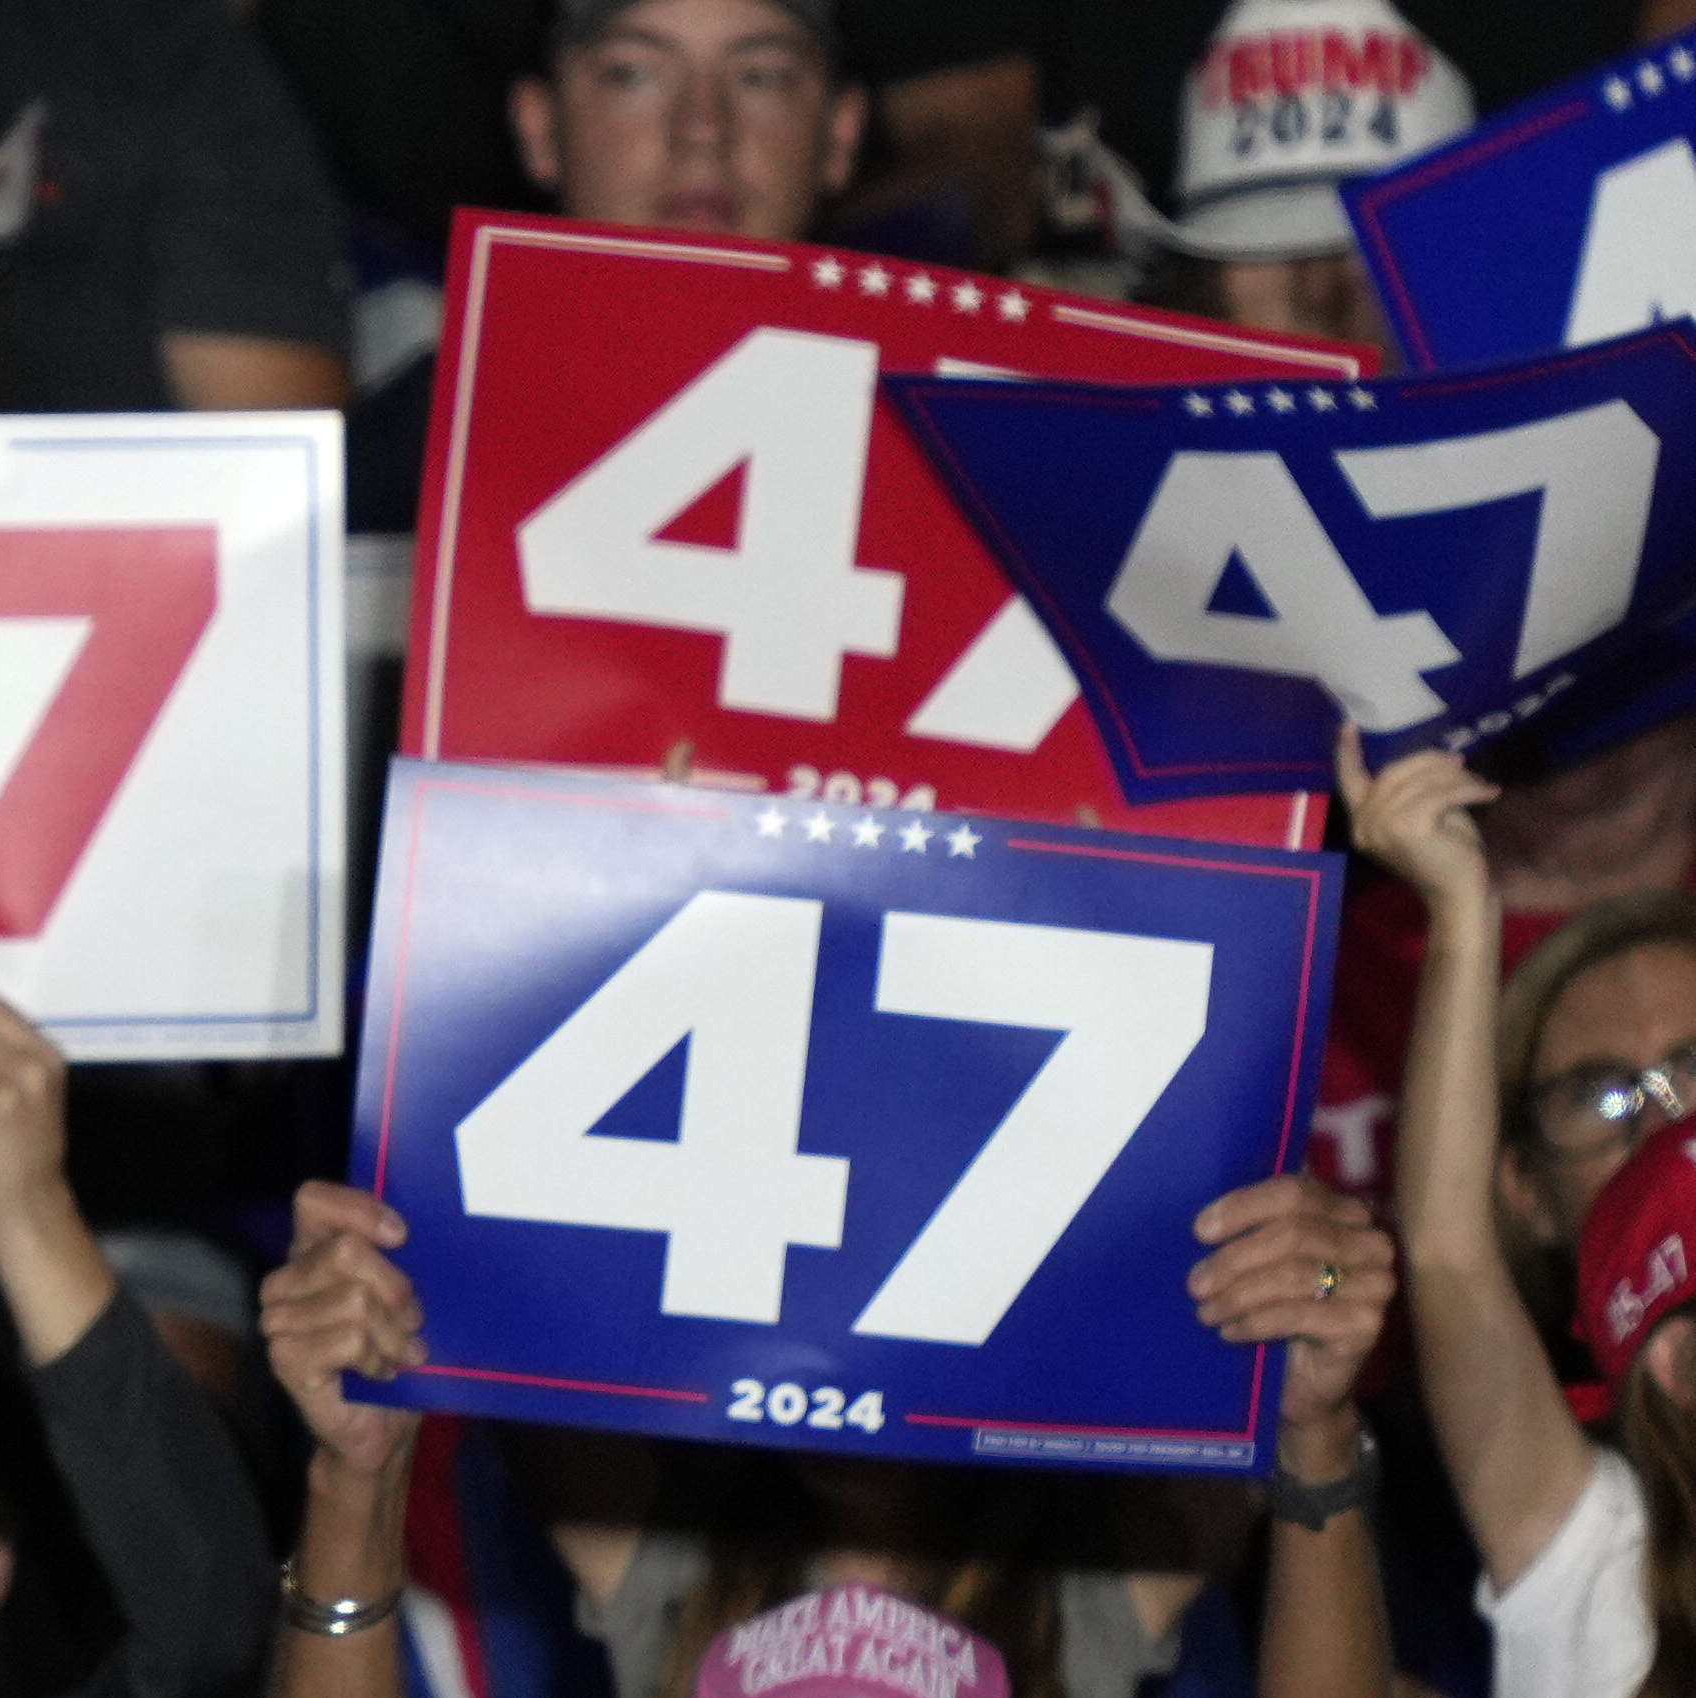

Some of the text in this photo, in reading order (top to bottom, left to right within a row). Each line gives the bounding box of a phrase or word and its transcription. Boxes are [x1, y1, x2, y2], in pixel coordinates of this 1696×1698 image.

[1199, 28, 1431, 110] TRUMP
[1229, 97, 1401, 155] 2024
[1104, 399, 1661, 732] 47
[454, 890, 1214, 1347] 47
[727, 1379, 886, 1434] 2024
[724, 1586, 978, 1688] MAKE AMERICA
[740, 1634, 847, 1698] GREAT
